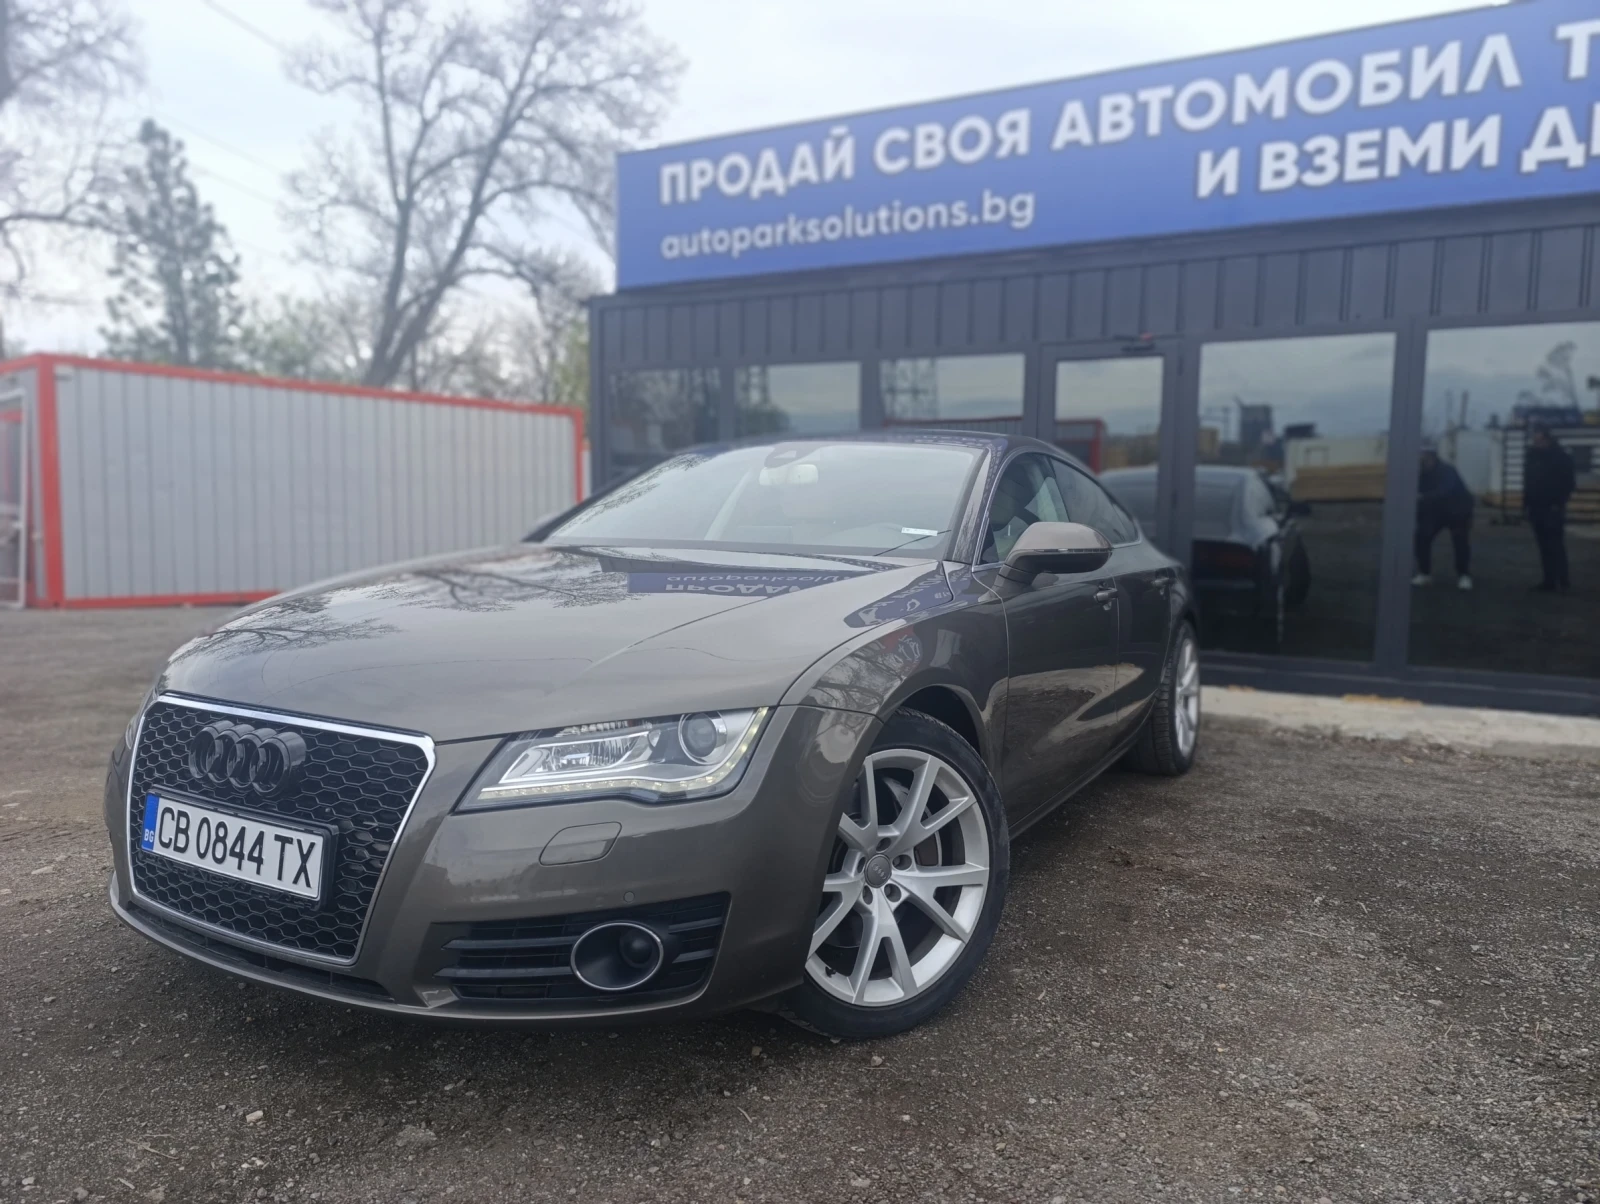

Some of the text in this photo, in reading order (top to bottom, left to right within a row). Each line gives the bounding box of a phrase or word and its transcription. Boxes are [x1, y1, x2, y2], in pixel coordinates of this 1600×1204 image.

[661, 127, 854, 204] ПРОДАЙ
[874, 108, 1031, 174] СВОЯ
[1051, 33, 1522, 151] АВТОМОБИЛ
[1196, 147, 1240, 199] И
[1258, 114, 1500, 192] ВЗЕМИ
[661, 189, 1035, 260] autoparksolutions.bg
[144, 828, 155, 843] BG
[159, 806, 190, 853] CB
[197, 817, 265, 875] 0844
[274, 835, 316, 888] TX
